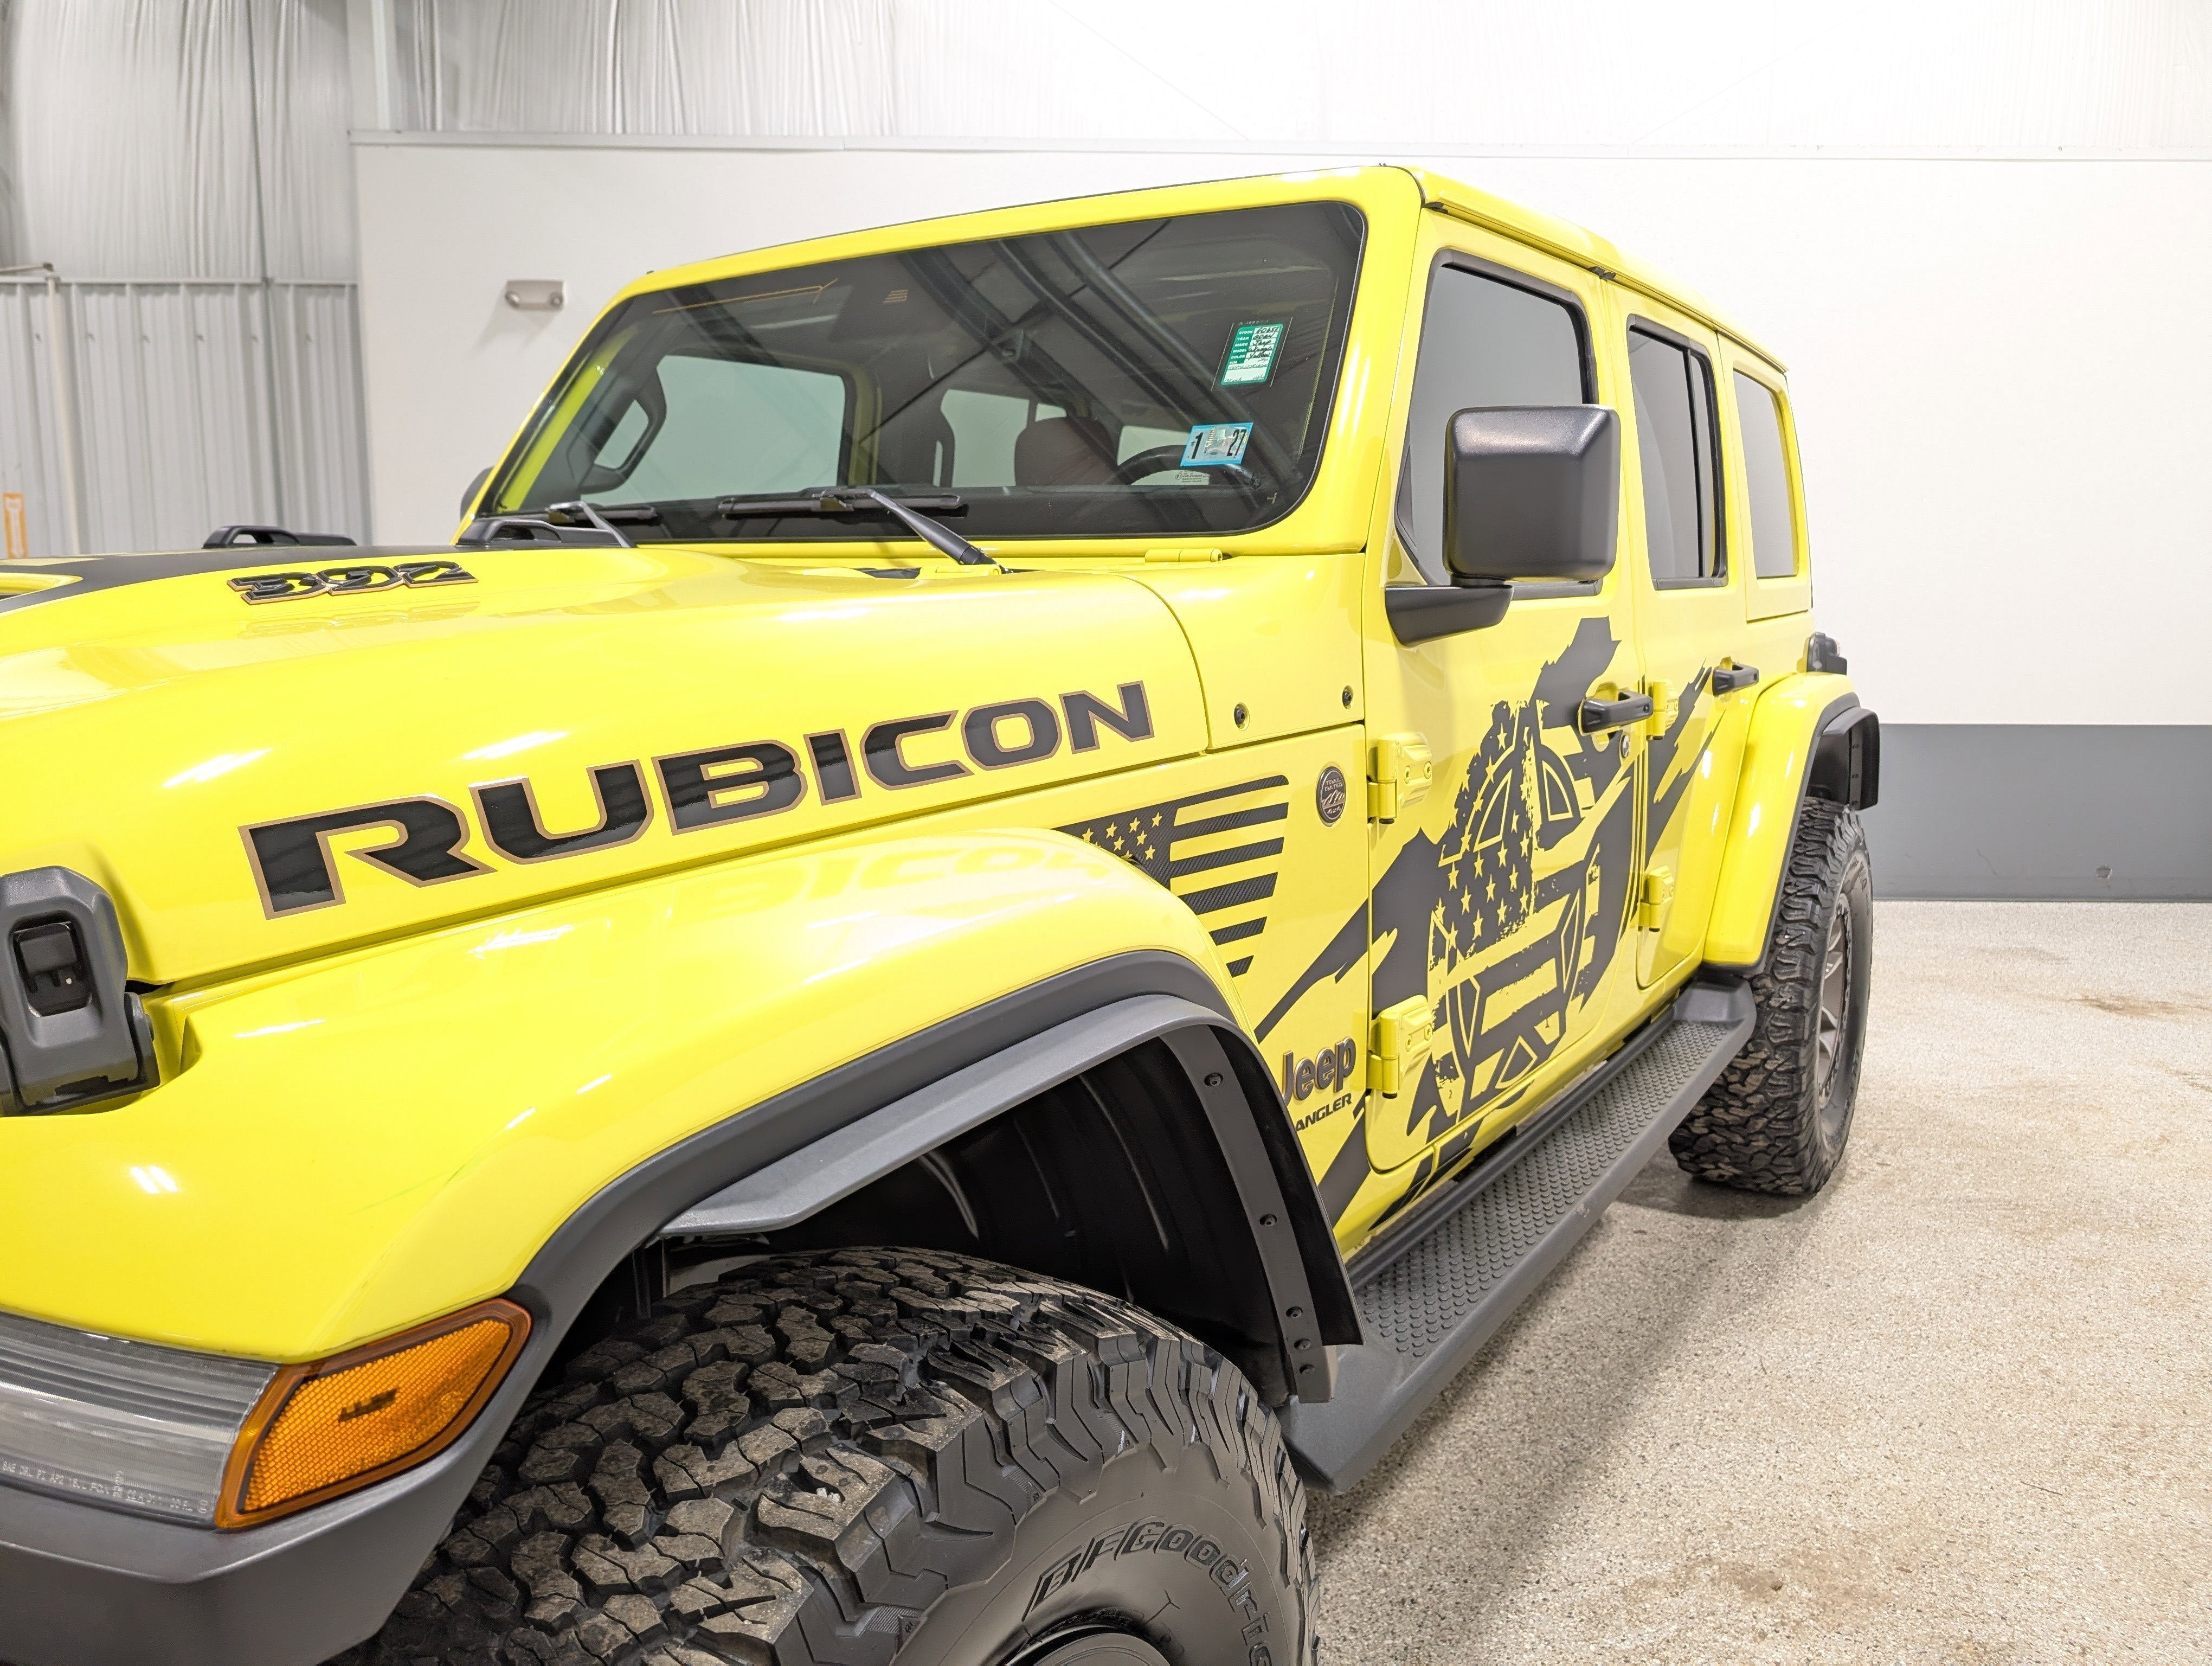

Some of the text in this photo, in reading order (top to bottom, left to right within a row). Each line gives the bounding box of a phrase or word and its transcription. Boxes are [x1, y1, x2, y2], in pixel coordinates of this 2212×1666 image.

[1191, 432, 1204, 459] 1
[1226, 429, 1247, 456] 27
[227, 561, 478, 605] 392
[1324, 783, 1343, 792] RATED
[1326, 777, 1342, 786] TRAIL
[239, 681, 1154, 920] RUBICON
[1282, 1036, 1356, 1107] Jeep
